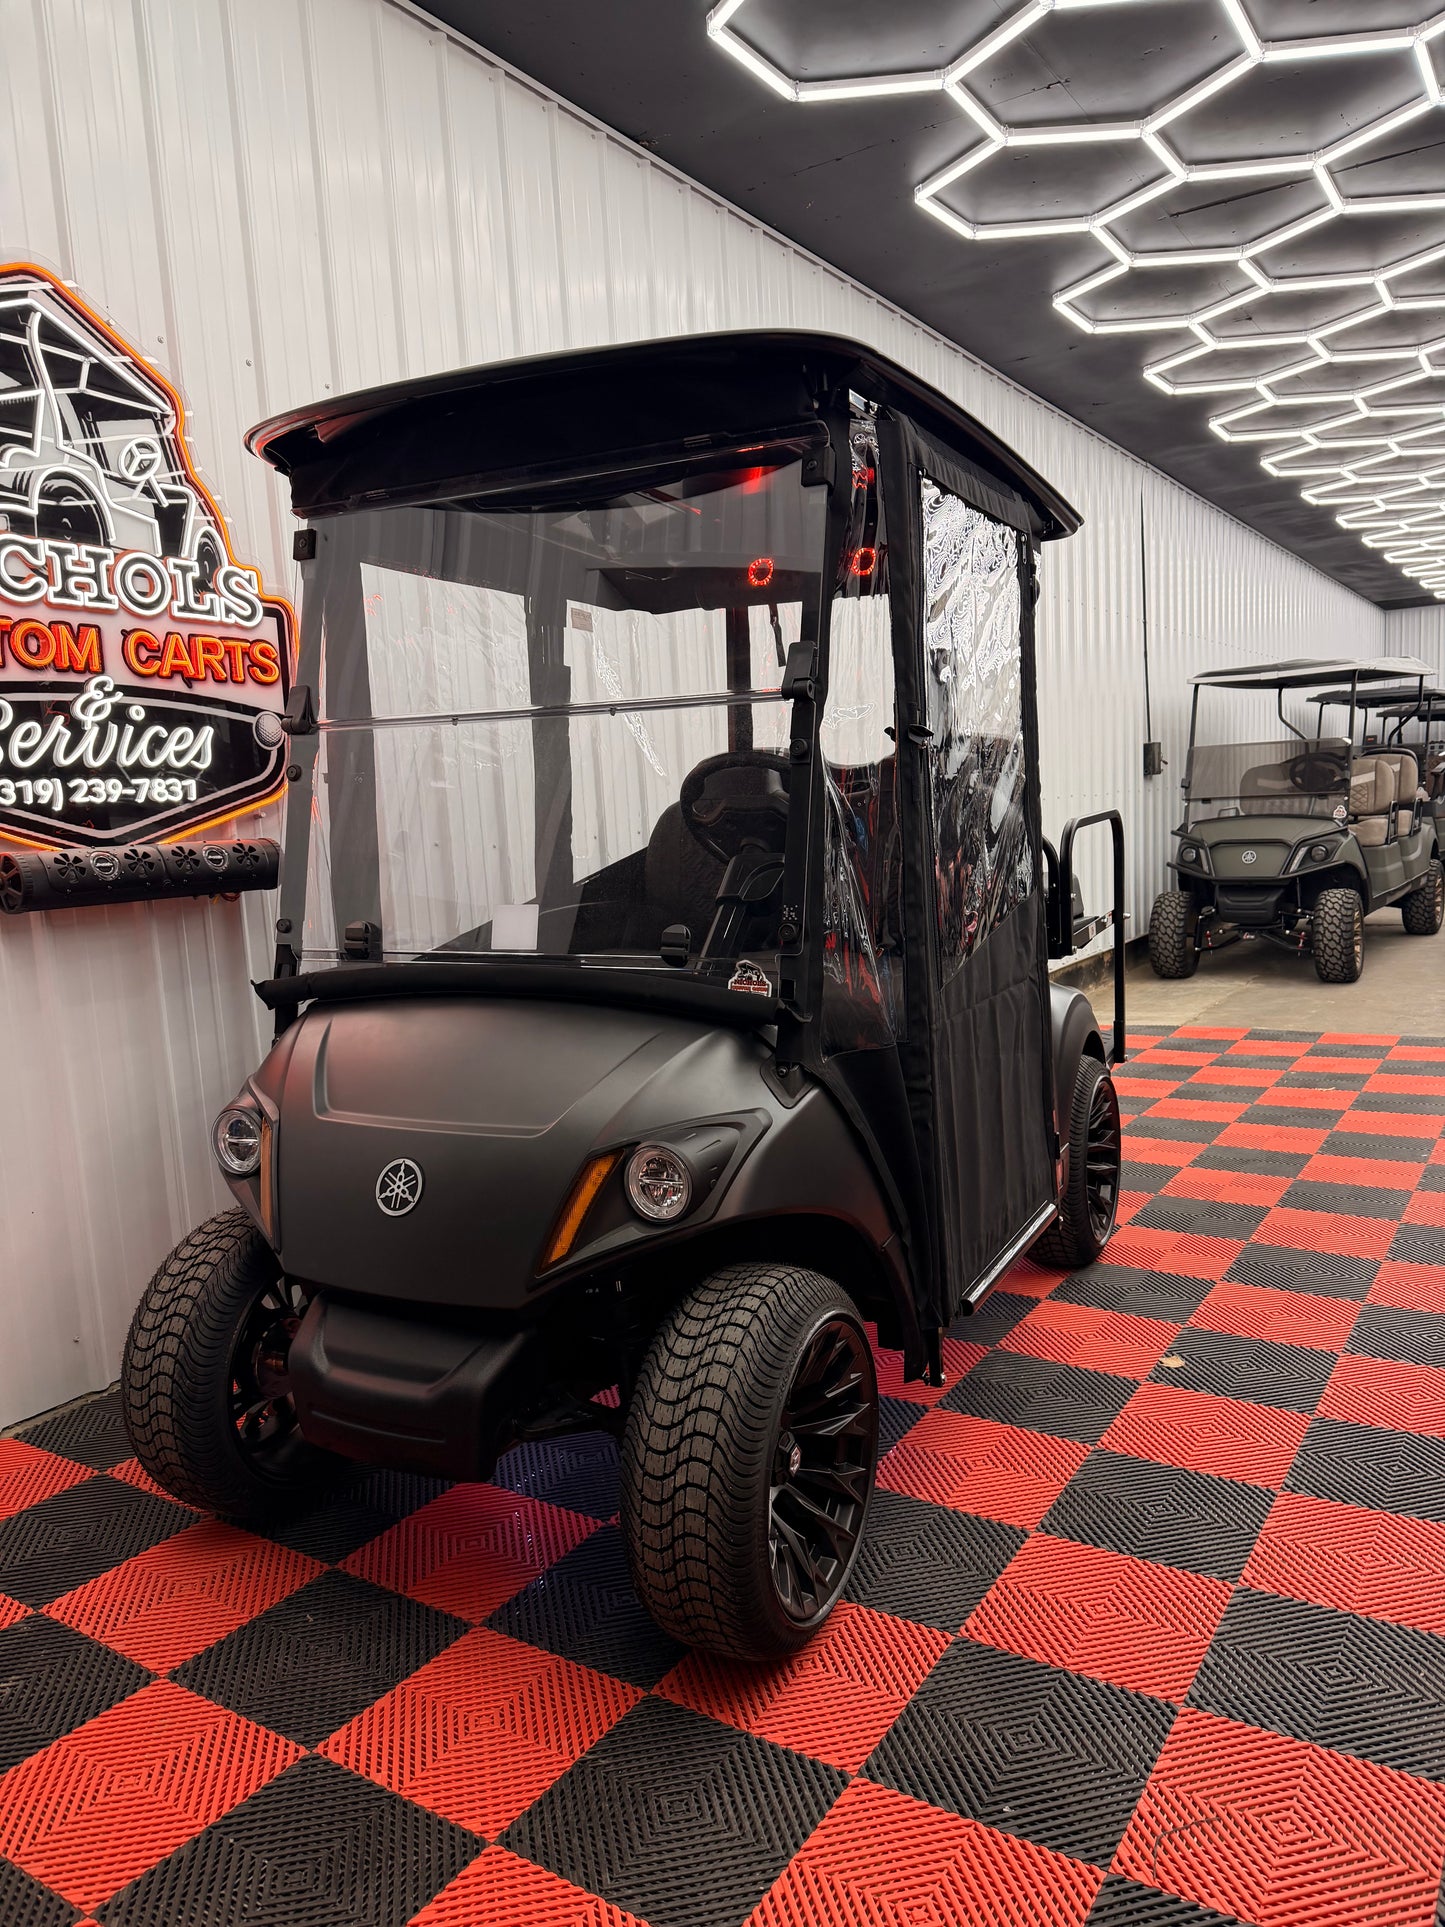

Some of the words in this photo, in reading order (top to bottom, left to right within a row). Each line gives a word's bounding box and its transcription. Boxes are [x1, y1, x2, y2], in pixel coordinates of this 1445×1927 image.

[122, 628, 281, 686] CARTS
[70, 675, 124, 731] &
[67, 778, 198, 805] 239-7831
